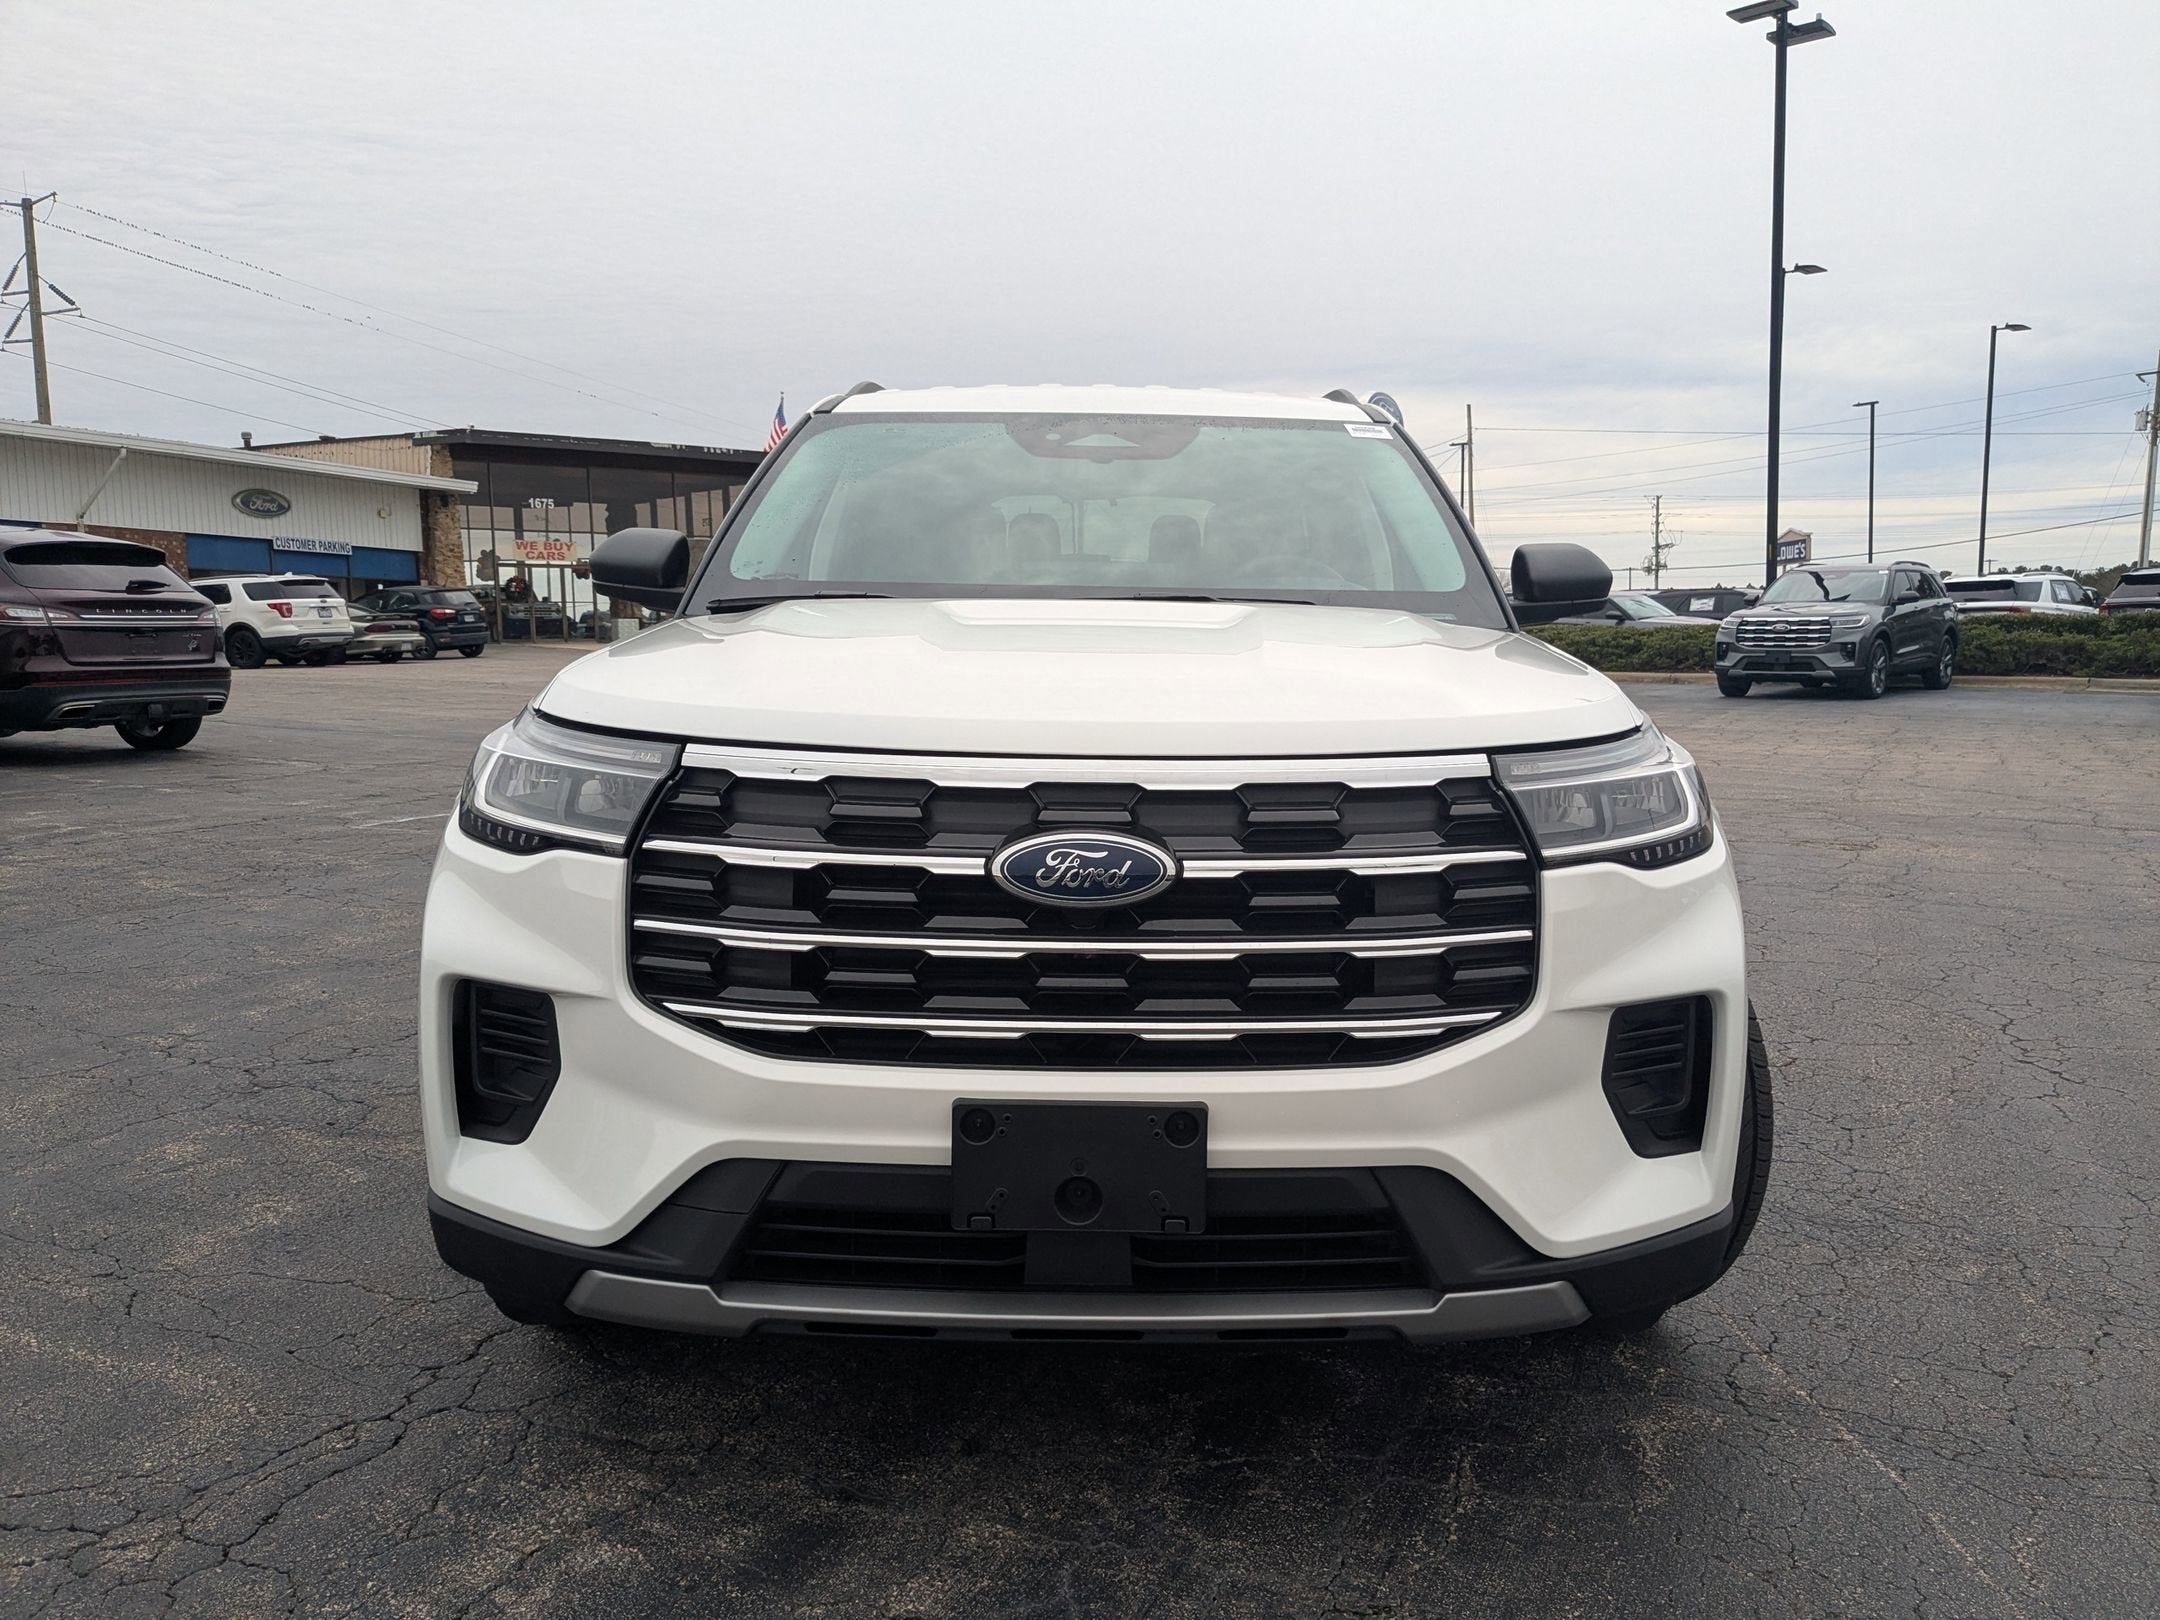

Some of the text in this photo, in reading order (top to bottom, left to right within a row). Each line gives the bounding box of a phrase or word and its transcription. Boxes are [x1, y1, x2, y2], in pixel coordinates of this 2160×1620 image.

[249, 495, 278, 511] Ford
[528, 498, 554, 509] 1675
[275, 537, 351, 553] CUSTOMER PARKING
[515, 541, 573, 551] WE BUY
[1777, 542, 1805, 561] OWE'S
[526, 551, 565, 560] CARS
[1035, 848, 1132, 889] Ford
